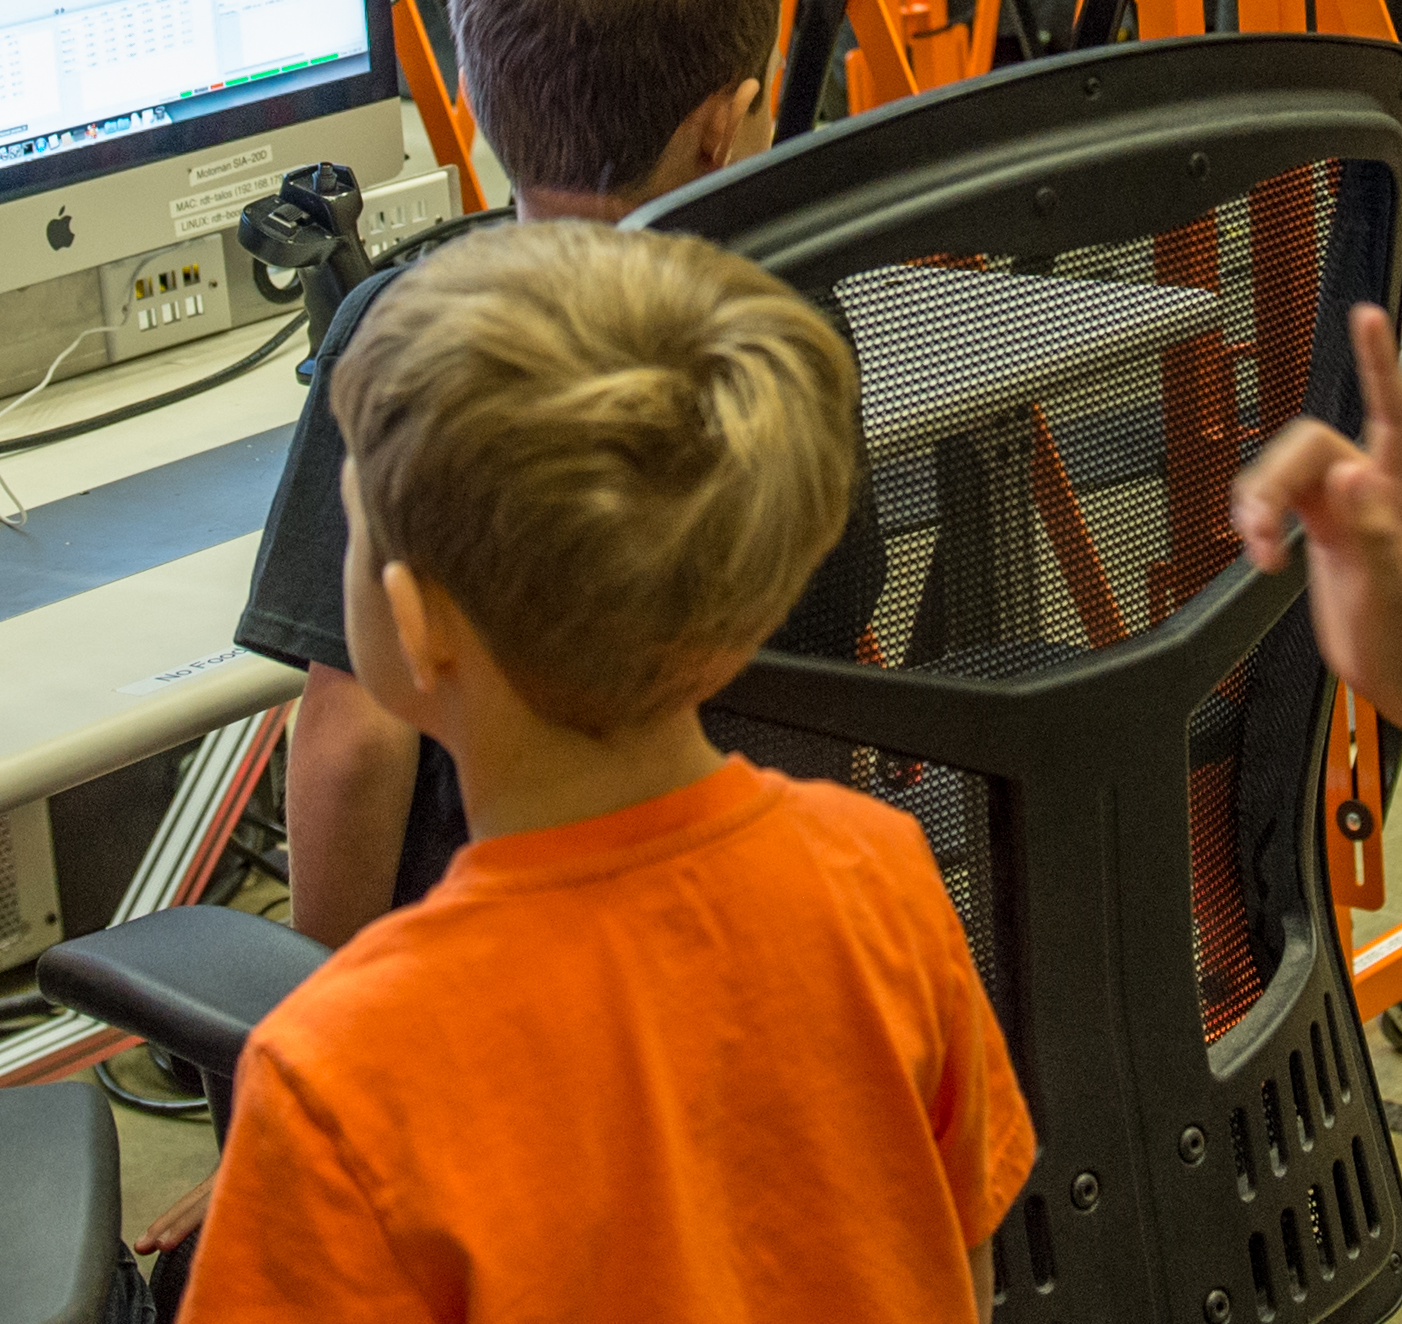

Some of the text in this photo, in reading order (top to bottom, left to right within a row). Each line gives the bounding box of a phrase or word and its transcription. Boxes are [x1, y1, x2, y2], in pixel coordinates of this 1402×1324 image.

[196, 161, 232, 179] Motoman
[176, 198, 199, 212] MAC:
[154, 669, 193, 682] No
